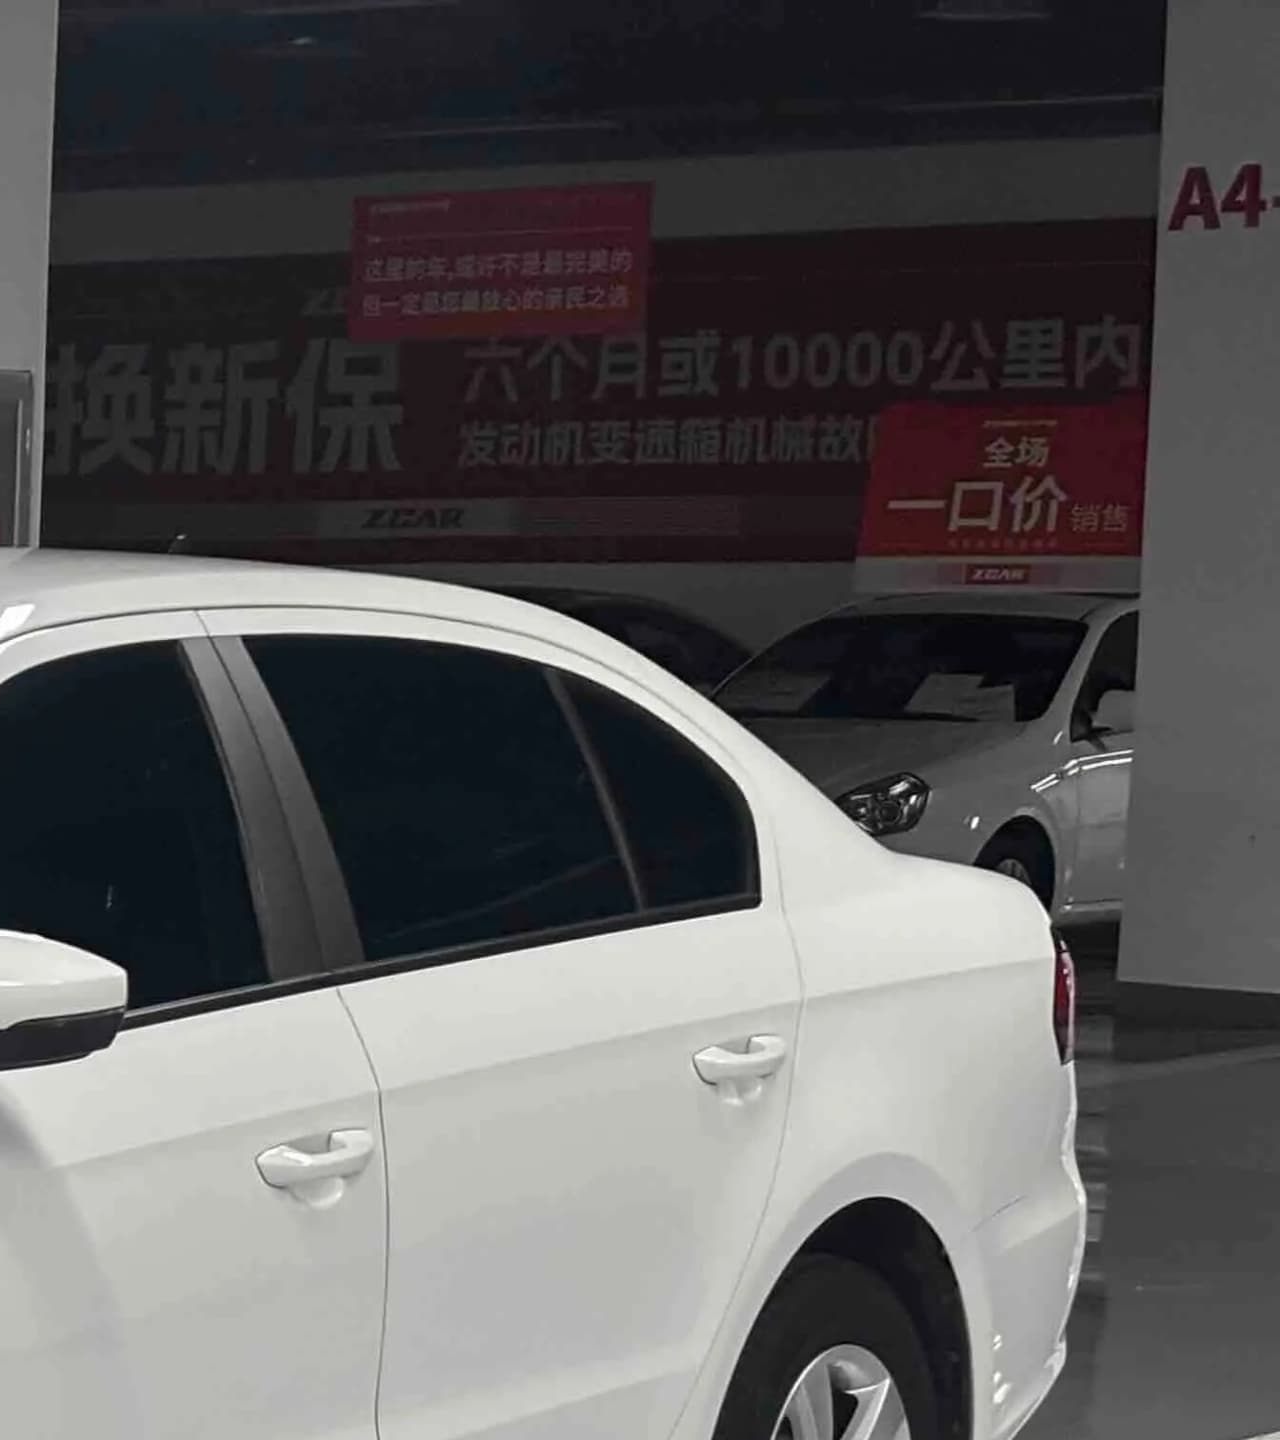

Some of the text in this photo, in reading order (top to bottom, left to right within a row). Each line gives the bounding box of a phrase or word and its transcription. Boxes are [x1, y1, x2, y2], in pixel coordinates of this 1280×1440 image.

[462, 315, 1142, 403] 六个月或10000公里内
[46, 338, 404, 475] 换新保
[982, 435, 1049, 469] 全场
[887, 474, 1130, 533] 一口价 销售
